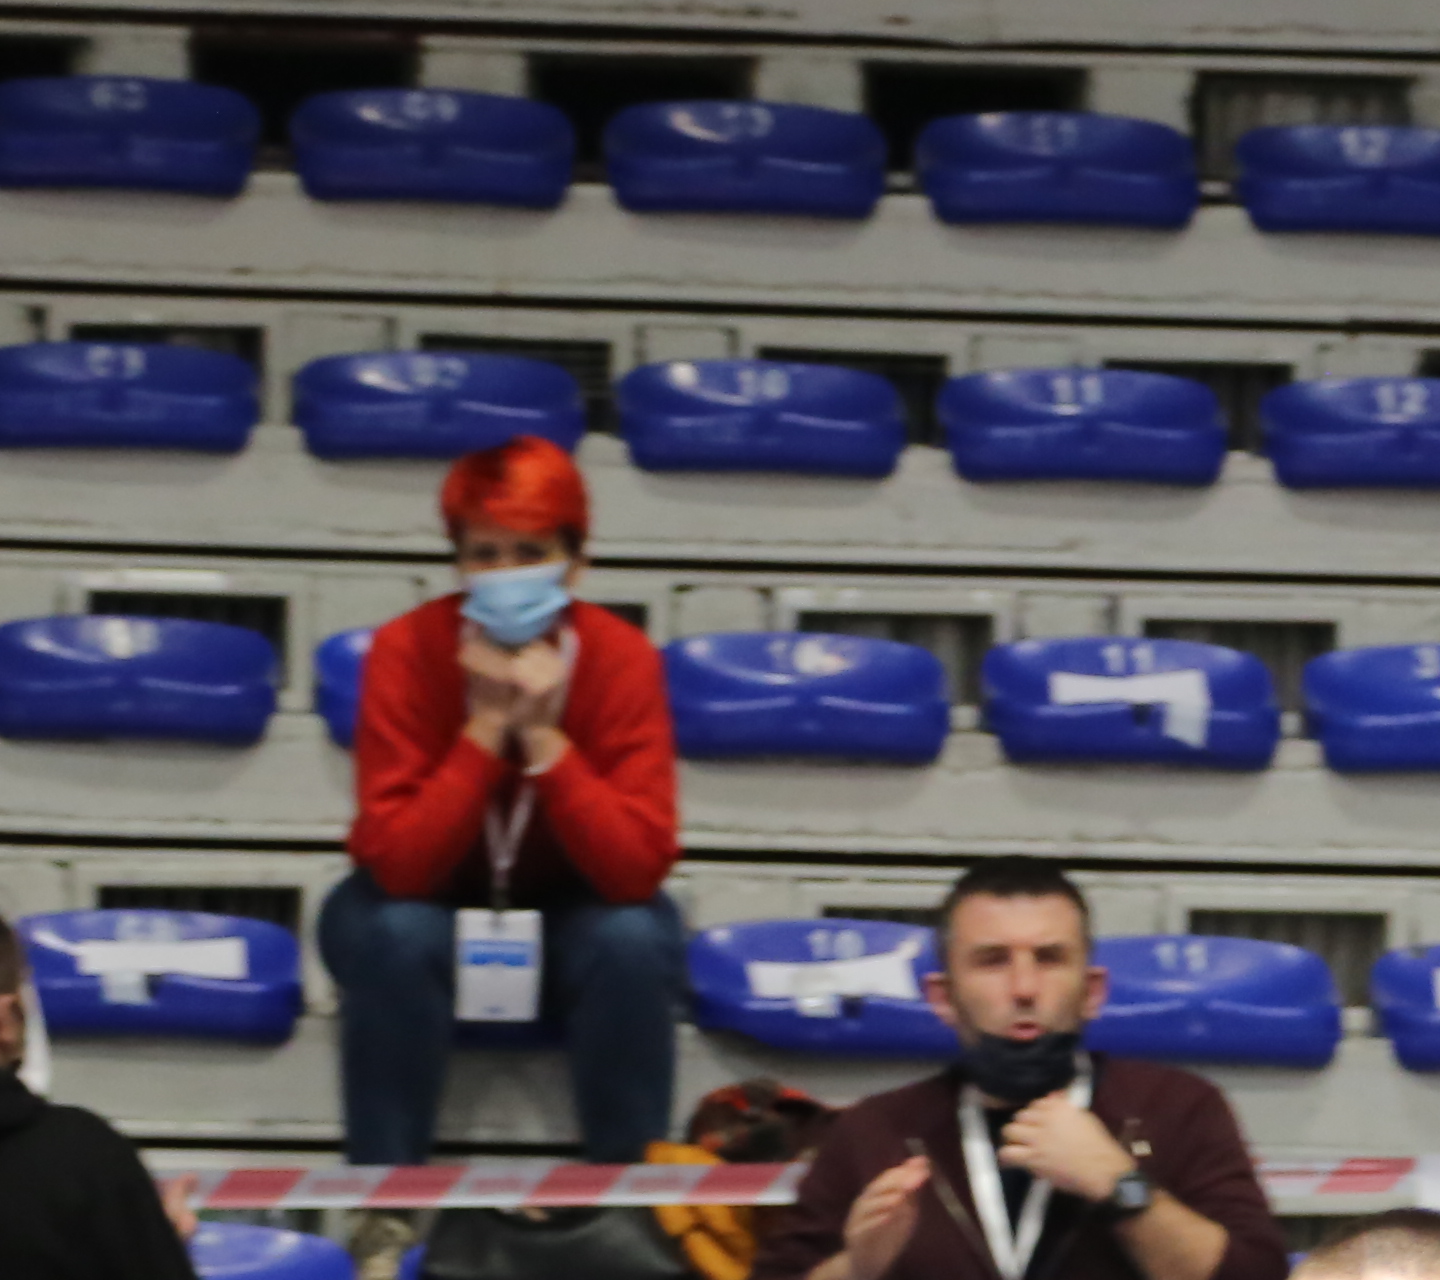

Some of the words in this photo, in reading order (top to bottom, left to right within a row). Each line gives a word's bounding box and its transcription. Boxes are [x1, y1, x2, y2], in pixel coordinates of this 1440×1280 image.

[1052, 375, 1103, 405] 11
[1374, 383, 1428, 416] 12
[1100, 644, 1155, 673] 11
[807, 928, 865, 960] 10
[1156, 942, 1209, 972] 11
